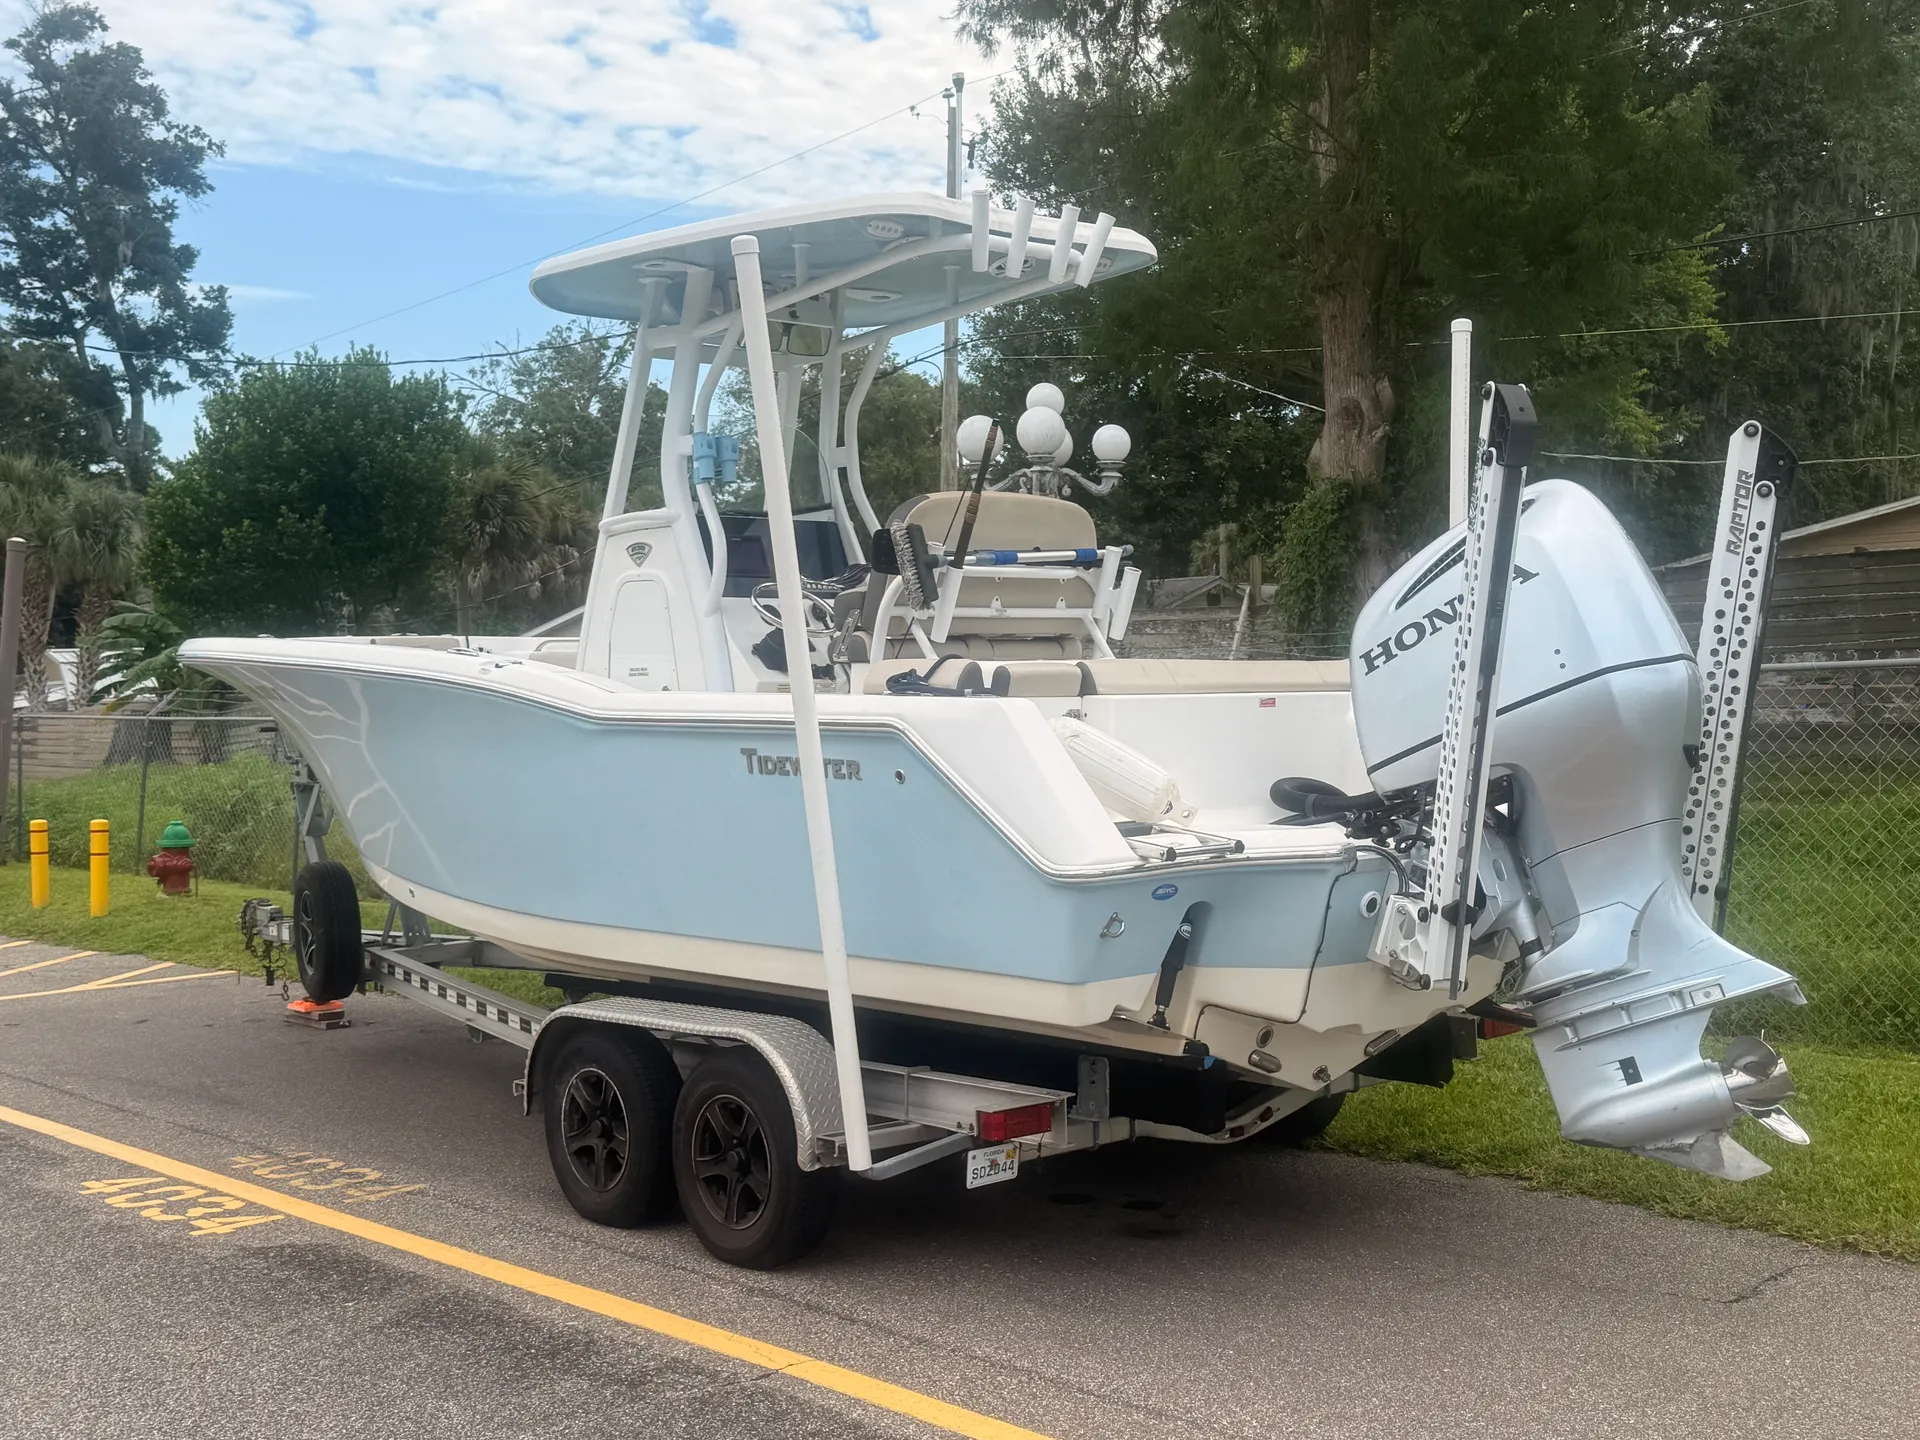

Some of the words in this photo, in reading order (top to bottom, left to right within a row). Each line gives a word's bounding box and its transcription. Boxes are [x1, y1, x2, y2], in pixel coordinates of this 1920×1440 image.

[1725, 468, 1754, 556] RAPTOR
[1359, 563, 1540, 677] HONA
[740, 747, 863, 781] TIDEWTER
[983, 1148, 1005, 1158] FLORIDA
[78, 1176, 286, 1237] 4034
